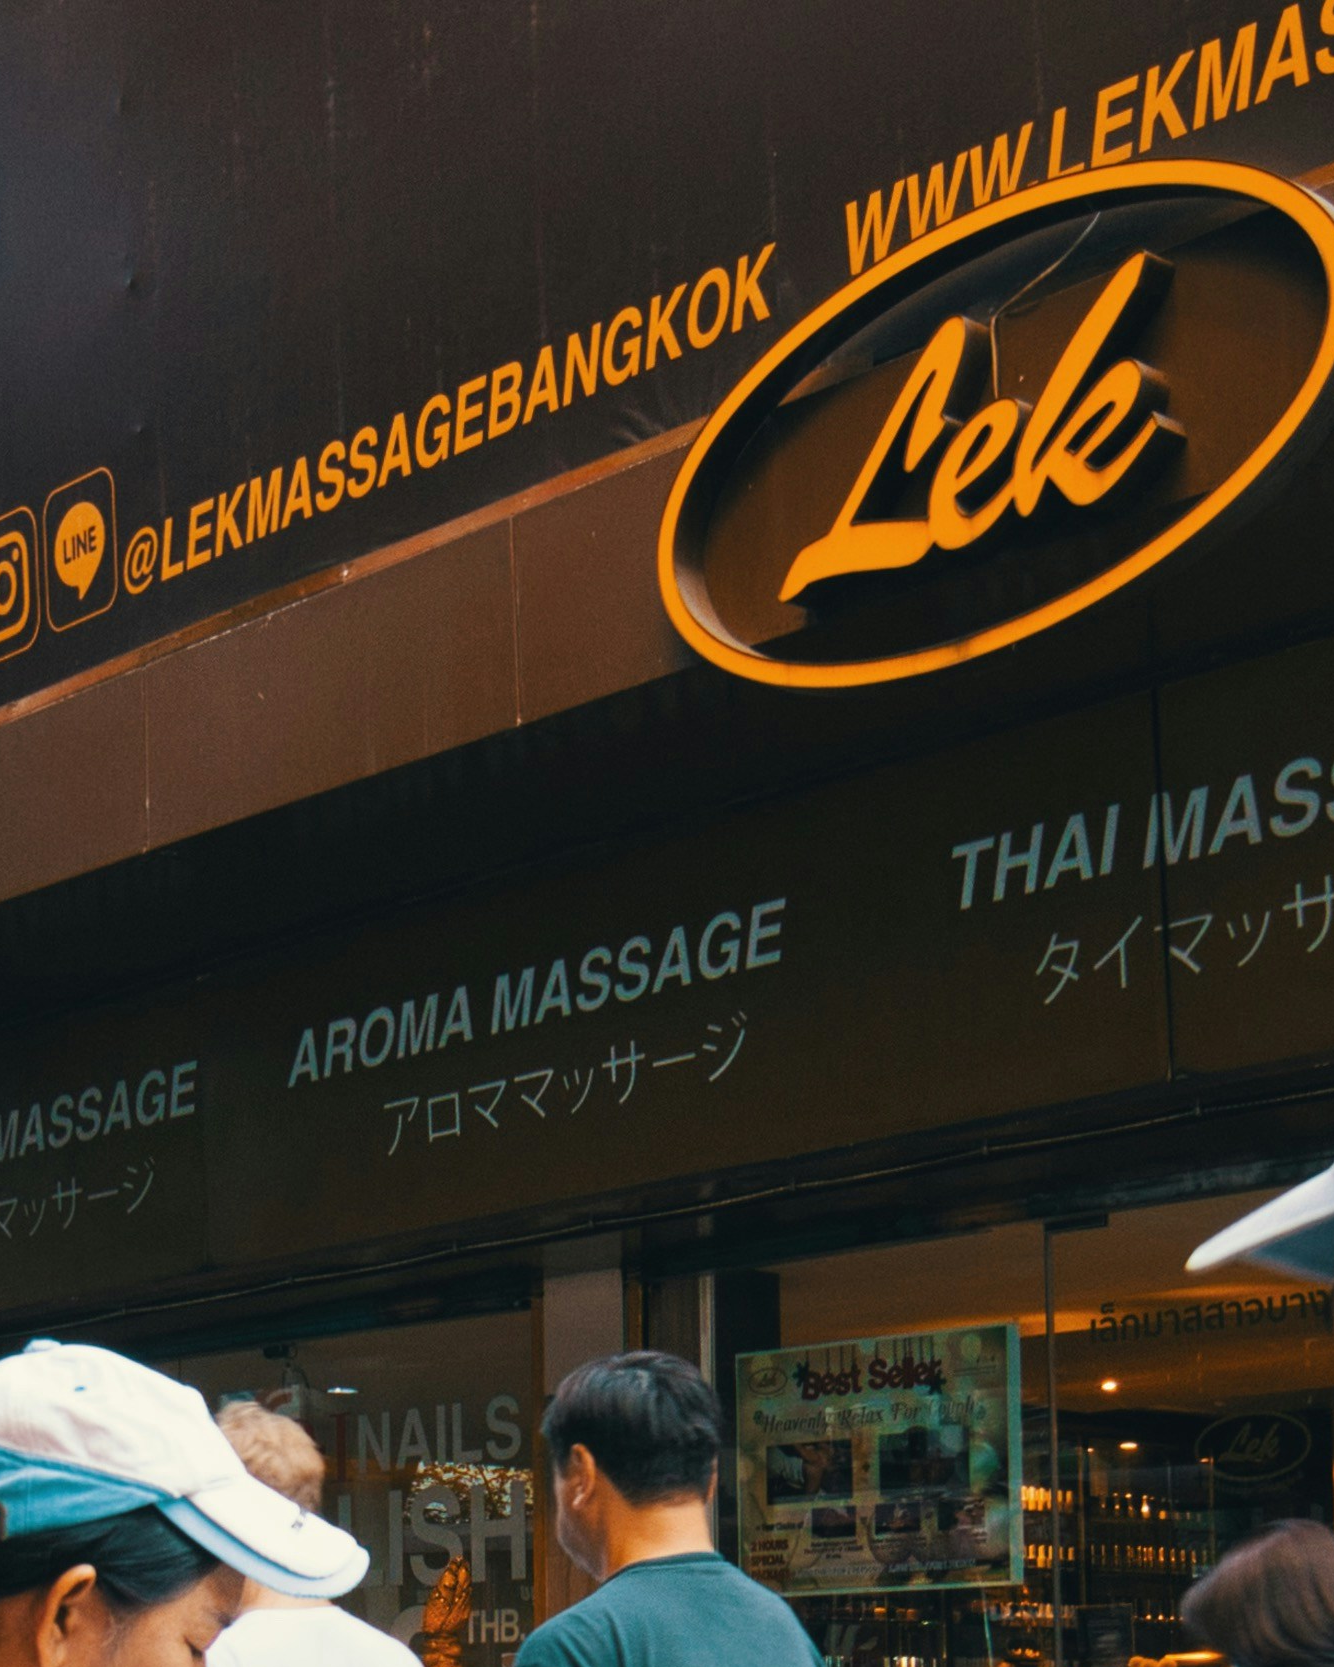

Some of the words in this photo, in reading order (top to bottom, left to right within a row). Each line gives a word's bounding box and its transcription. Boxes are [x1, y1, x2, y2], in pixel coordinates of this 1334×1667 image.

[124, 242, 778, 595] @LEKMASSAGEBANGKOK
[778, 249, 1187, 604] Lek
[63, 525, 97, 565] LINE
[951, 804, 1121, 911] THAI
[287, 985, 473, 1089] AROMA
[489, 897, 787, 1035] MASSAGE
[383, 1009, 747, 1157] アロママッサージ
[357, 1393, 523, 1474] NAILS
[801, 1366, 863, 1401] Best
[867, 1356, 943, 1390] Seller
